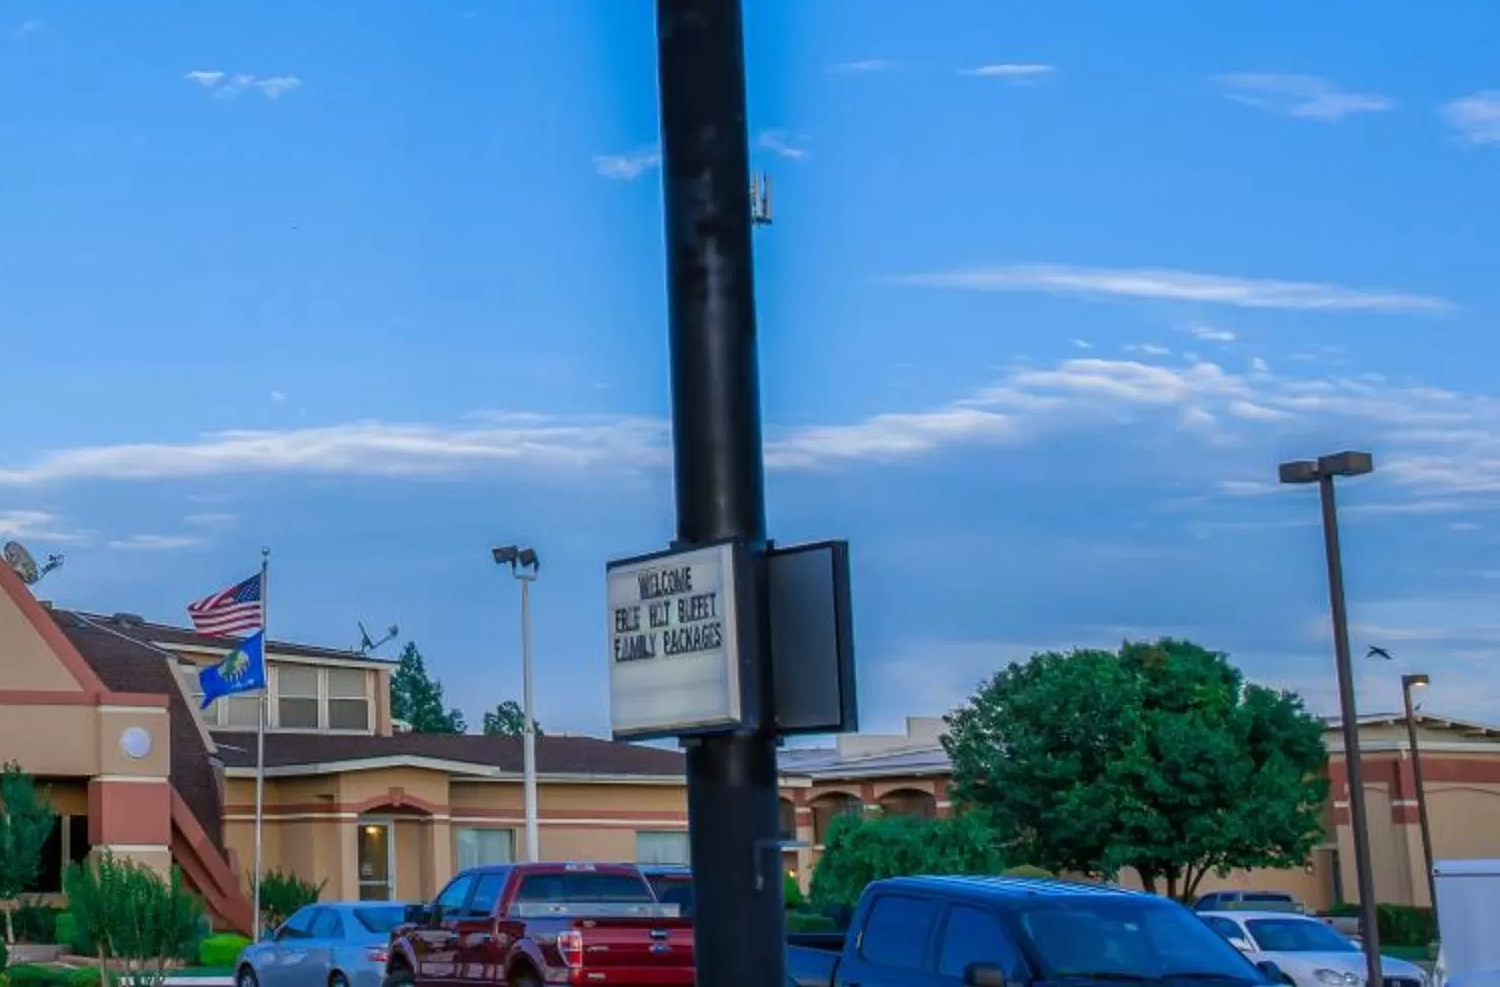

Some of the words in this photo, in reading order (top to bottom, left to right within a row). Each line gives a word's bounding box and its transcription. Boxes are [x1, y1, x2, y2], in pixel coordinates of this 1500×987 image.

[638, 566, 693, 600] WELCOME
[649, 600, 670, 629] HOT
[678, 593, 716, 623] BUFFET
[614, 633, 656, 662] FAMILY
[663, 622, 722, 655] PACKAGES
